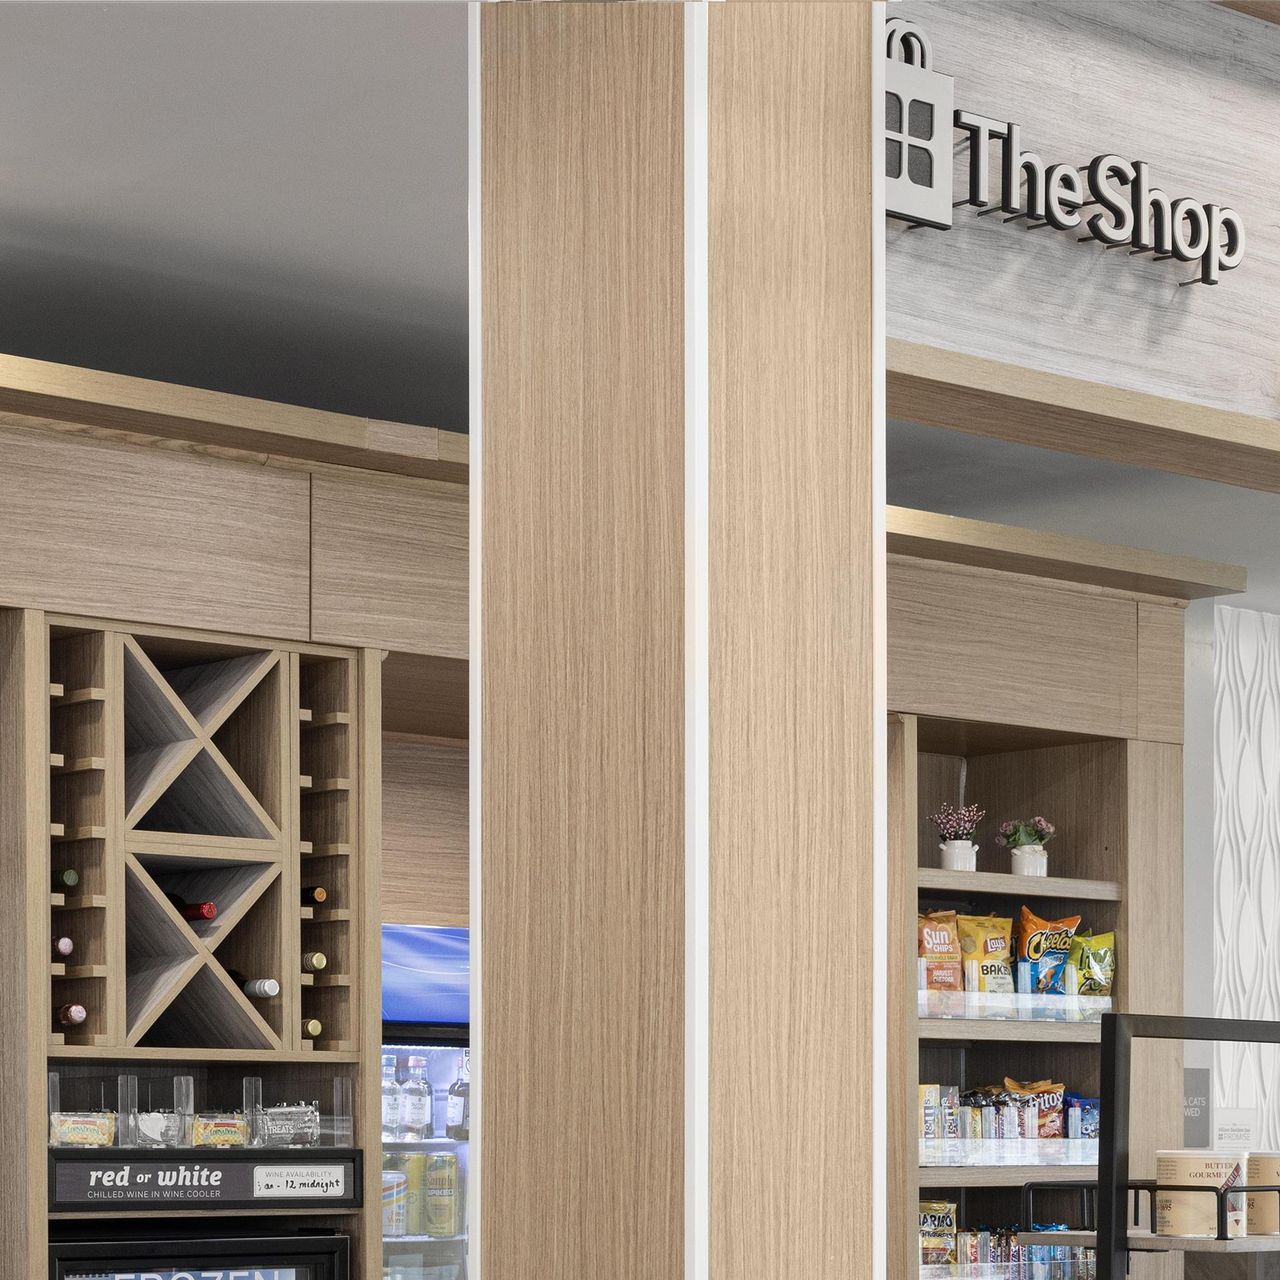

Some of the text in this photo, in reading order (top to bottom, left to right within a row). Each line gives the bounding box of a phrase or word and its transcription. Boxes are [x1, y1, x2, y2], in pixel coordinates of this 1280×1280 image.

[923, 927, 950, 949] Sun
[933, 944, 954, 953] CHIPS
[1028, 1090, 1063, 1111] Fritos
[1188, 1096, 1206, 1106] CATS
[268, 1125, 294, 1134] TREATS
[89, 1165, 223, 1187] red or white
[1189, 1171, 1228, 1179] GOURMET
[285, 1180, 296, 1189] 12
[299, 1179, 340, 1193] midnight
[87, 1189, 221, 1199] CHILLED WINE IN WINE COOLER
[921, 1213, 953, 1228] ARIBO
